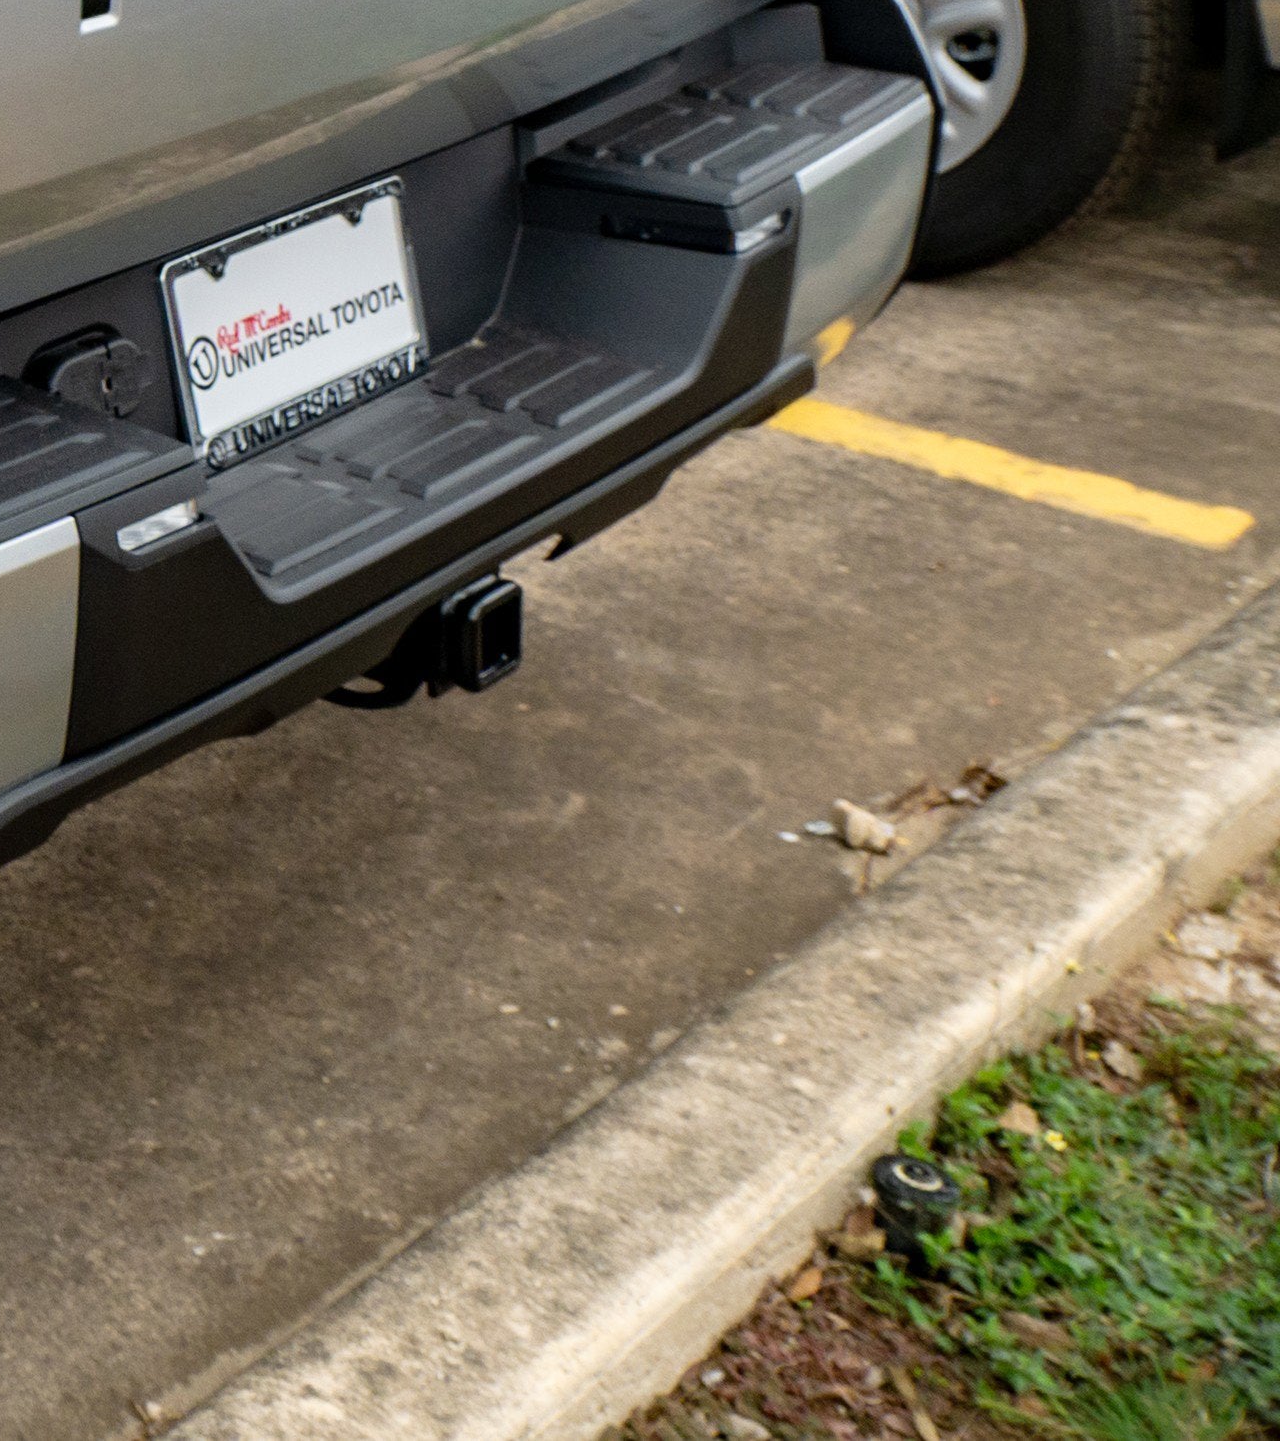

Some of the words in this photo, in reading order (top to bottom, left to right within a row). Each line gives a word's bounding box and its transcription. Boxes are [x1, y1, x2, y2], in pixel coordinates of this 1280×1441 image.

[221, 313, 330, 378] UNIVERSAL
[330, 282, 404, 329] TOYOTA
[233, 384, 354, 453] UNIVERSAL
